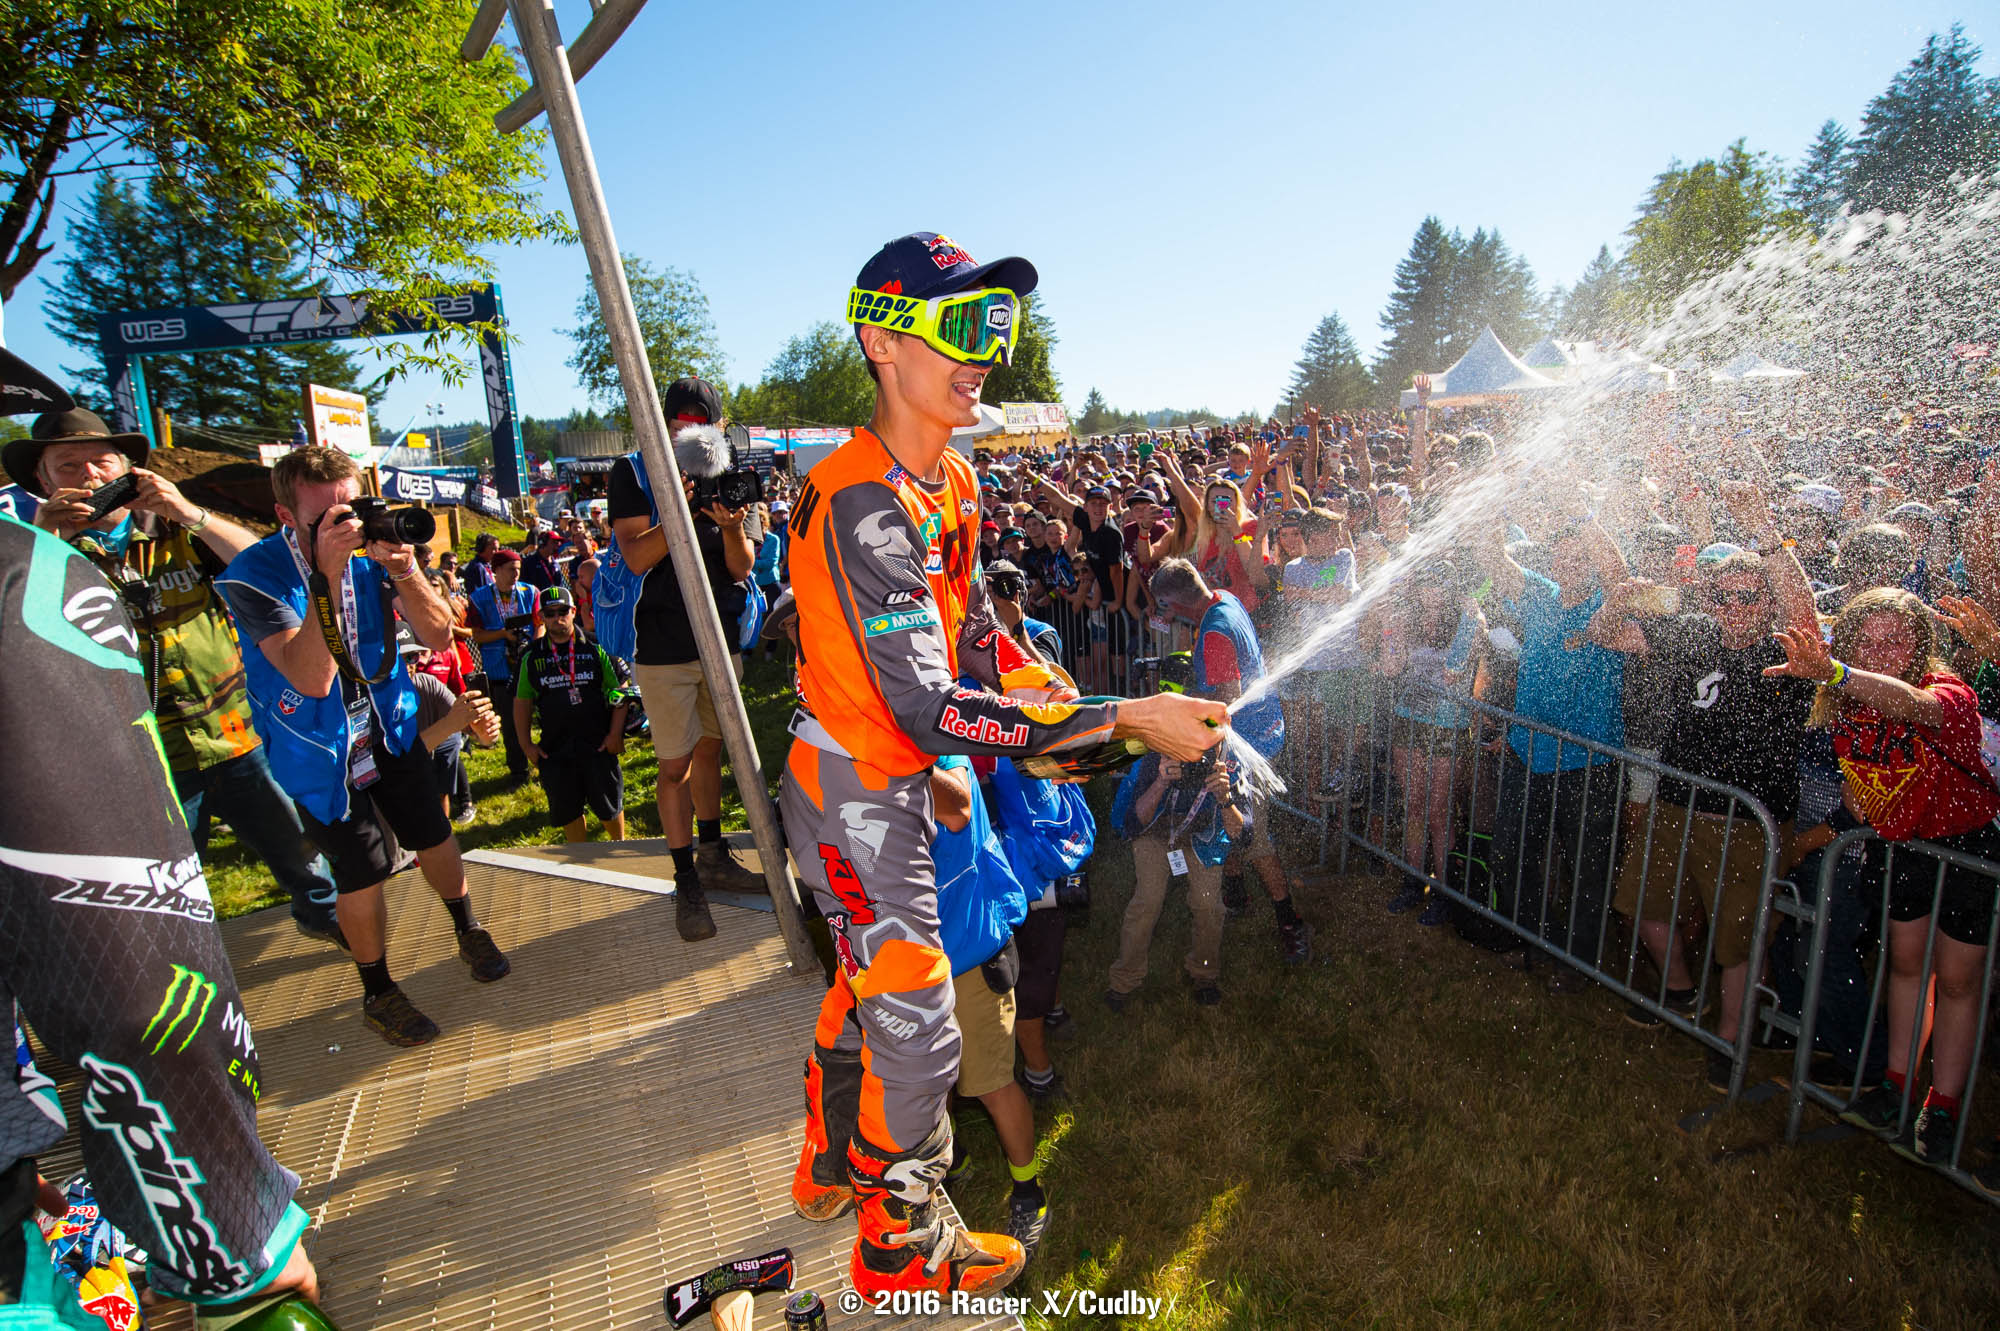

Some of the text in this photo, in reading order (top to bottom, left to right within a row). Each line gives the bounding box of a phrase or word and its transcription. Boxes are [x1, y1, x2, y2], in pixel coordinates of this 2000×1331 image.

[848, 291, 920, 330] 100%
[991, 311, 1010, 328] 100%
[120, 317, 187, 344] WPS
[249, 326, 352, 343] RACING
[397, 473, 434, 500] WPS
[317, 596, 332, 627] Nikon
[873, 1003, 919, 1041] THOR
[733, 1259, 761, 1273] 450
